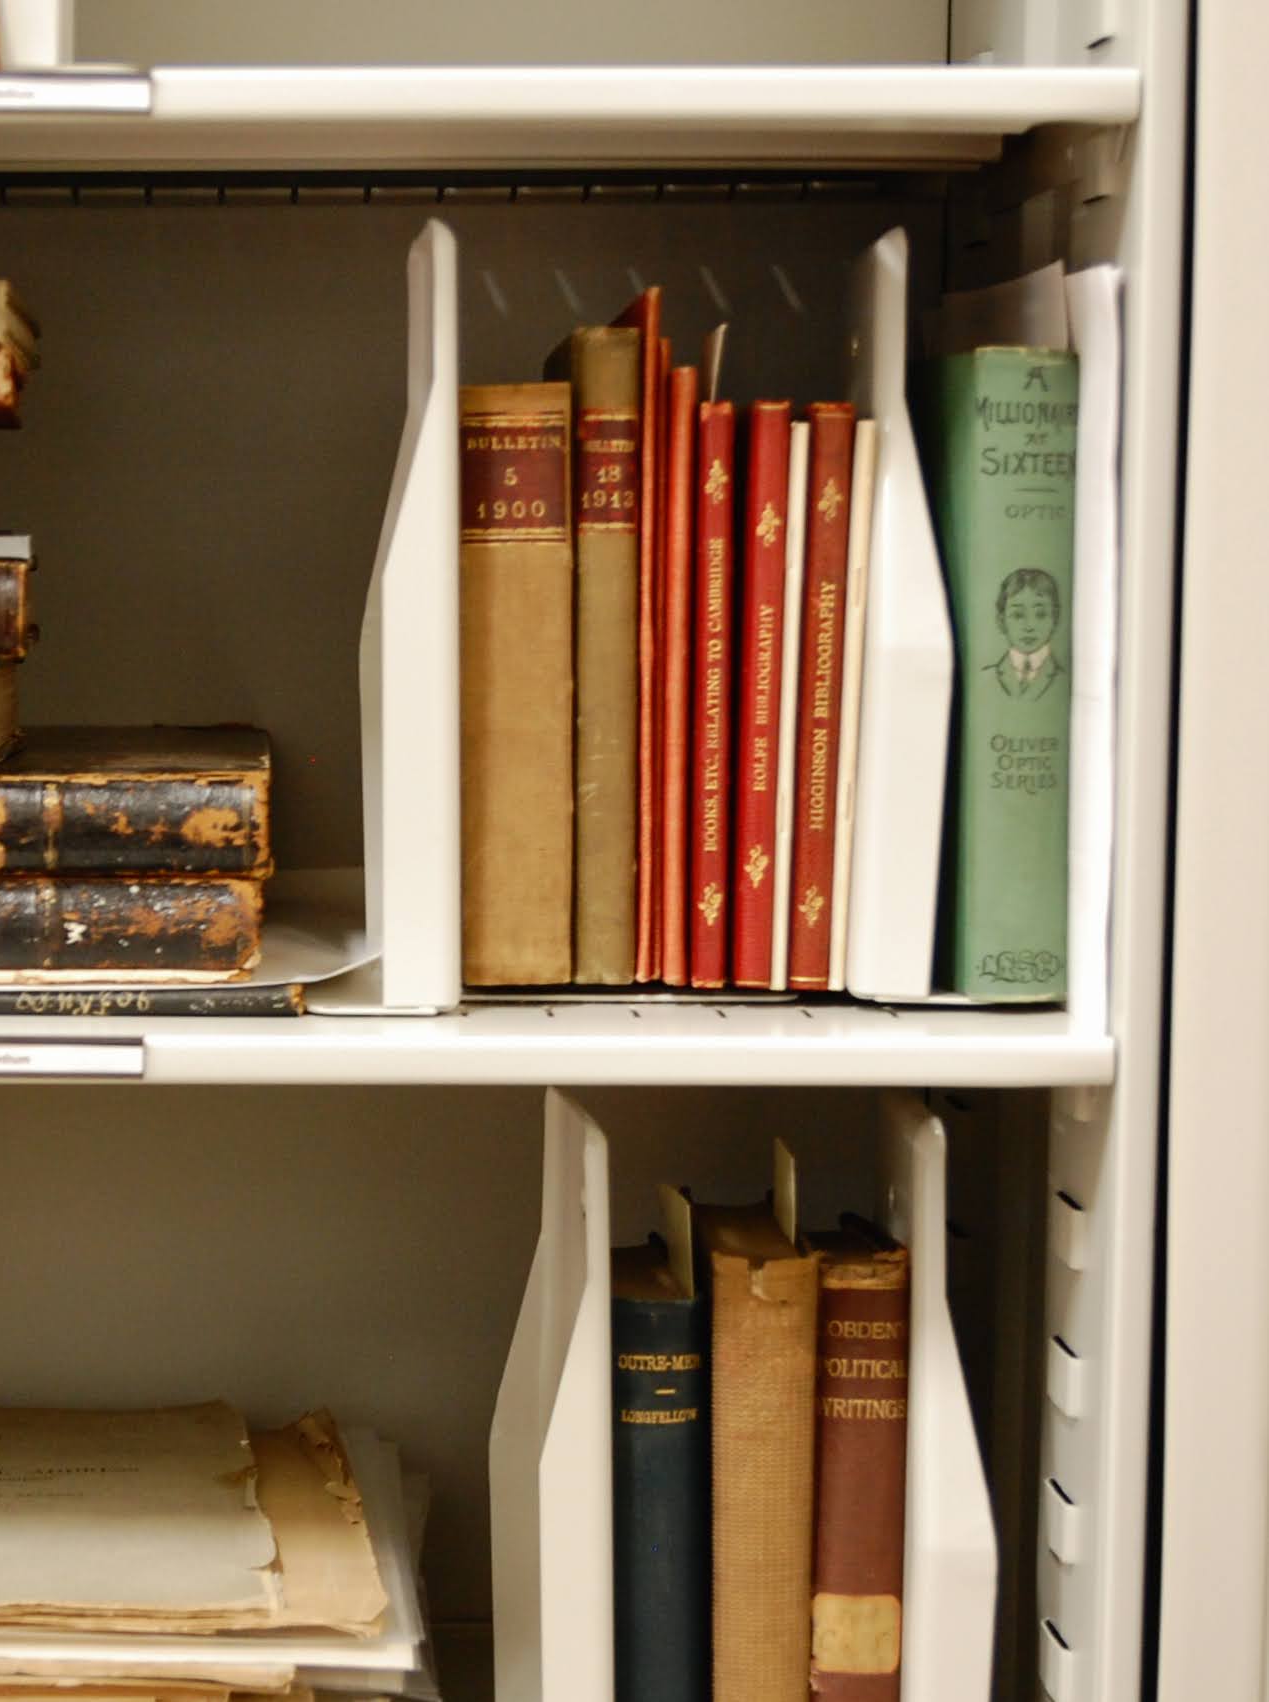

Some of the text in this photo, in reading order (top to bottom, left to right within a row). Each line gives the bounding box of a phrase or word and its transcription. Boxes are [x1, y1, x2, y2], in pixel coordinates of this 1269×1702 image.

[1023, 366, 1049, 392] A
[466, 434, 562, 450] BULLETIN
[504, 467, 519, 486] 5
[595, 464, 621, 484] 18
[476, 500, 547, 519] 1900
[1004, 503, 1066, 520] OPTIC
[707, 536, 725, 633] CAMBRIDGE
[707, 639, 723, 661] TO
[753, 604, 775, 792] ROLFE BIBLIOGRAPHY
[810, 580, 839, 830] HIGGINSON BIBLIOGRAPHY
[706, 668, 722, 750] RELATING
[990, 734, 1059, 753] OLIVER
[998, 754, 1051, 771] OPTIC
[990, 773, 1058, 795] SERIES
[827, 1320, 901, 1339] OBDEN
[824, 1358, 907, 1378] OLITICAL
[620, 1407, 698, 1425] LONGFELLOW
